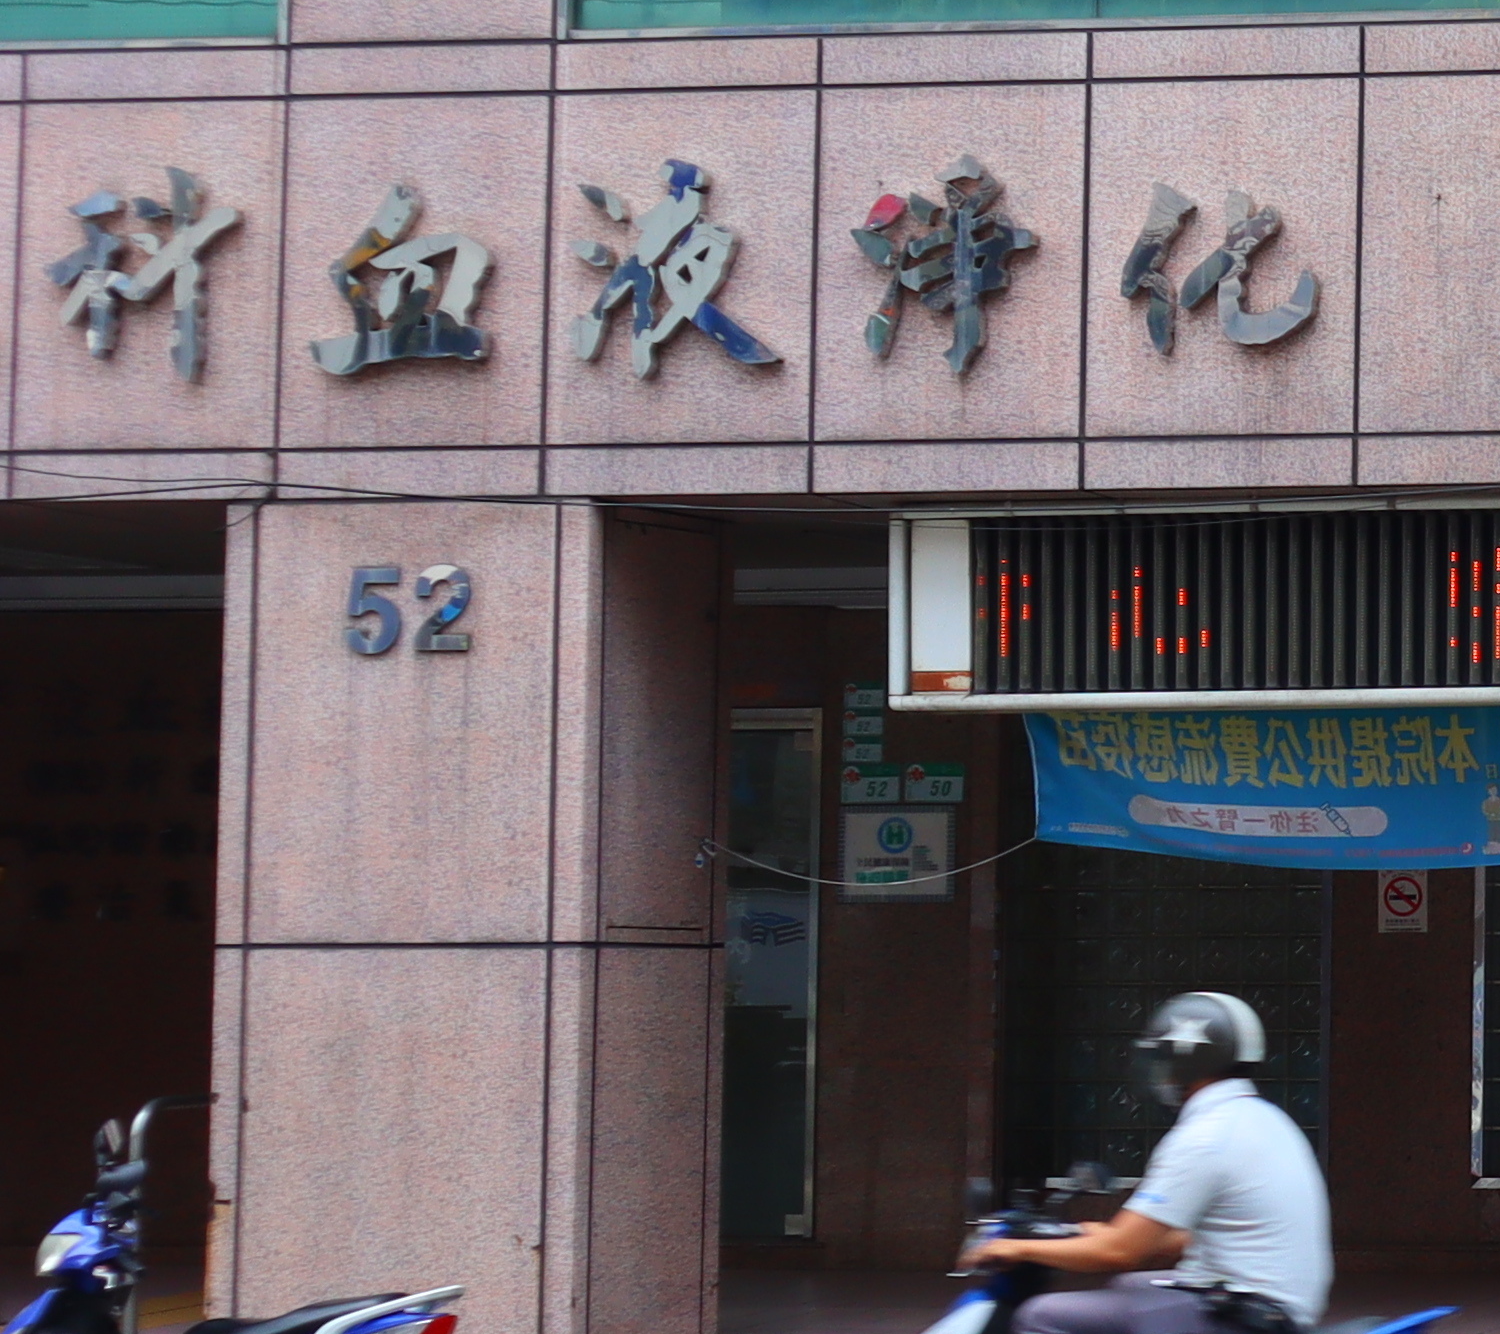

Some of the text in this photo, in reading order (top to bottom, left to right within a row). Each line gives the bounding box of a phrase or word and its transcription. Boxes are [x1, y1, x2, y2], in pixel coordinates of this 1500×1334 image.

[344, 565, 472, 656] 52
[866, 781, 888, 797] 52
[930, 780, 953, 796] 50
